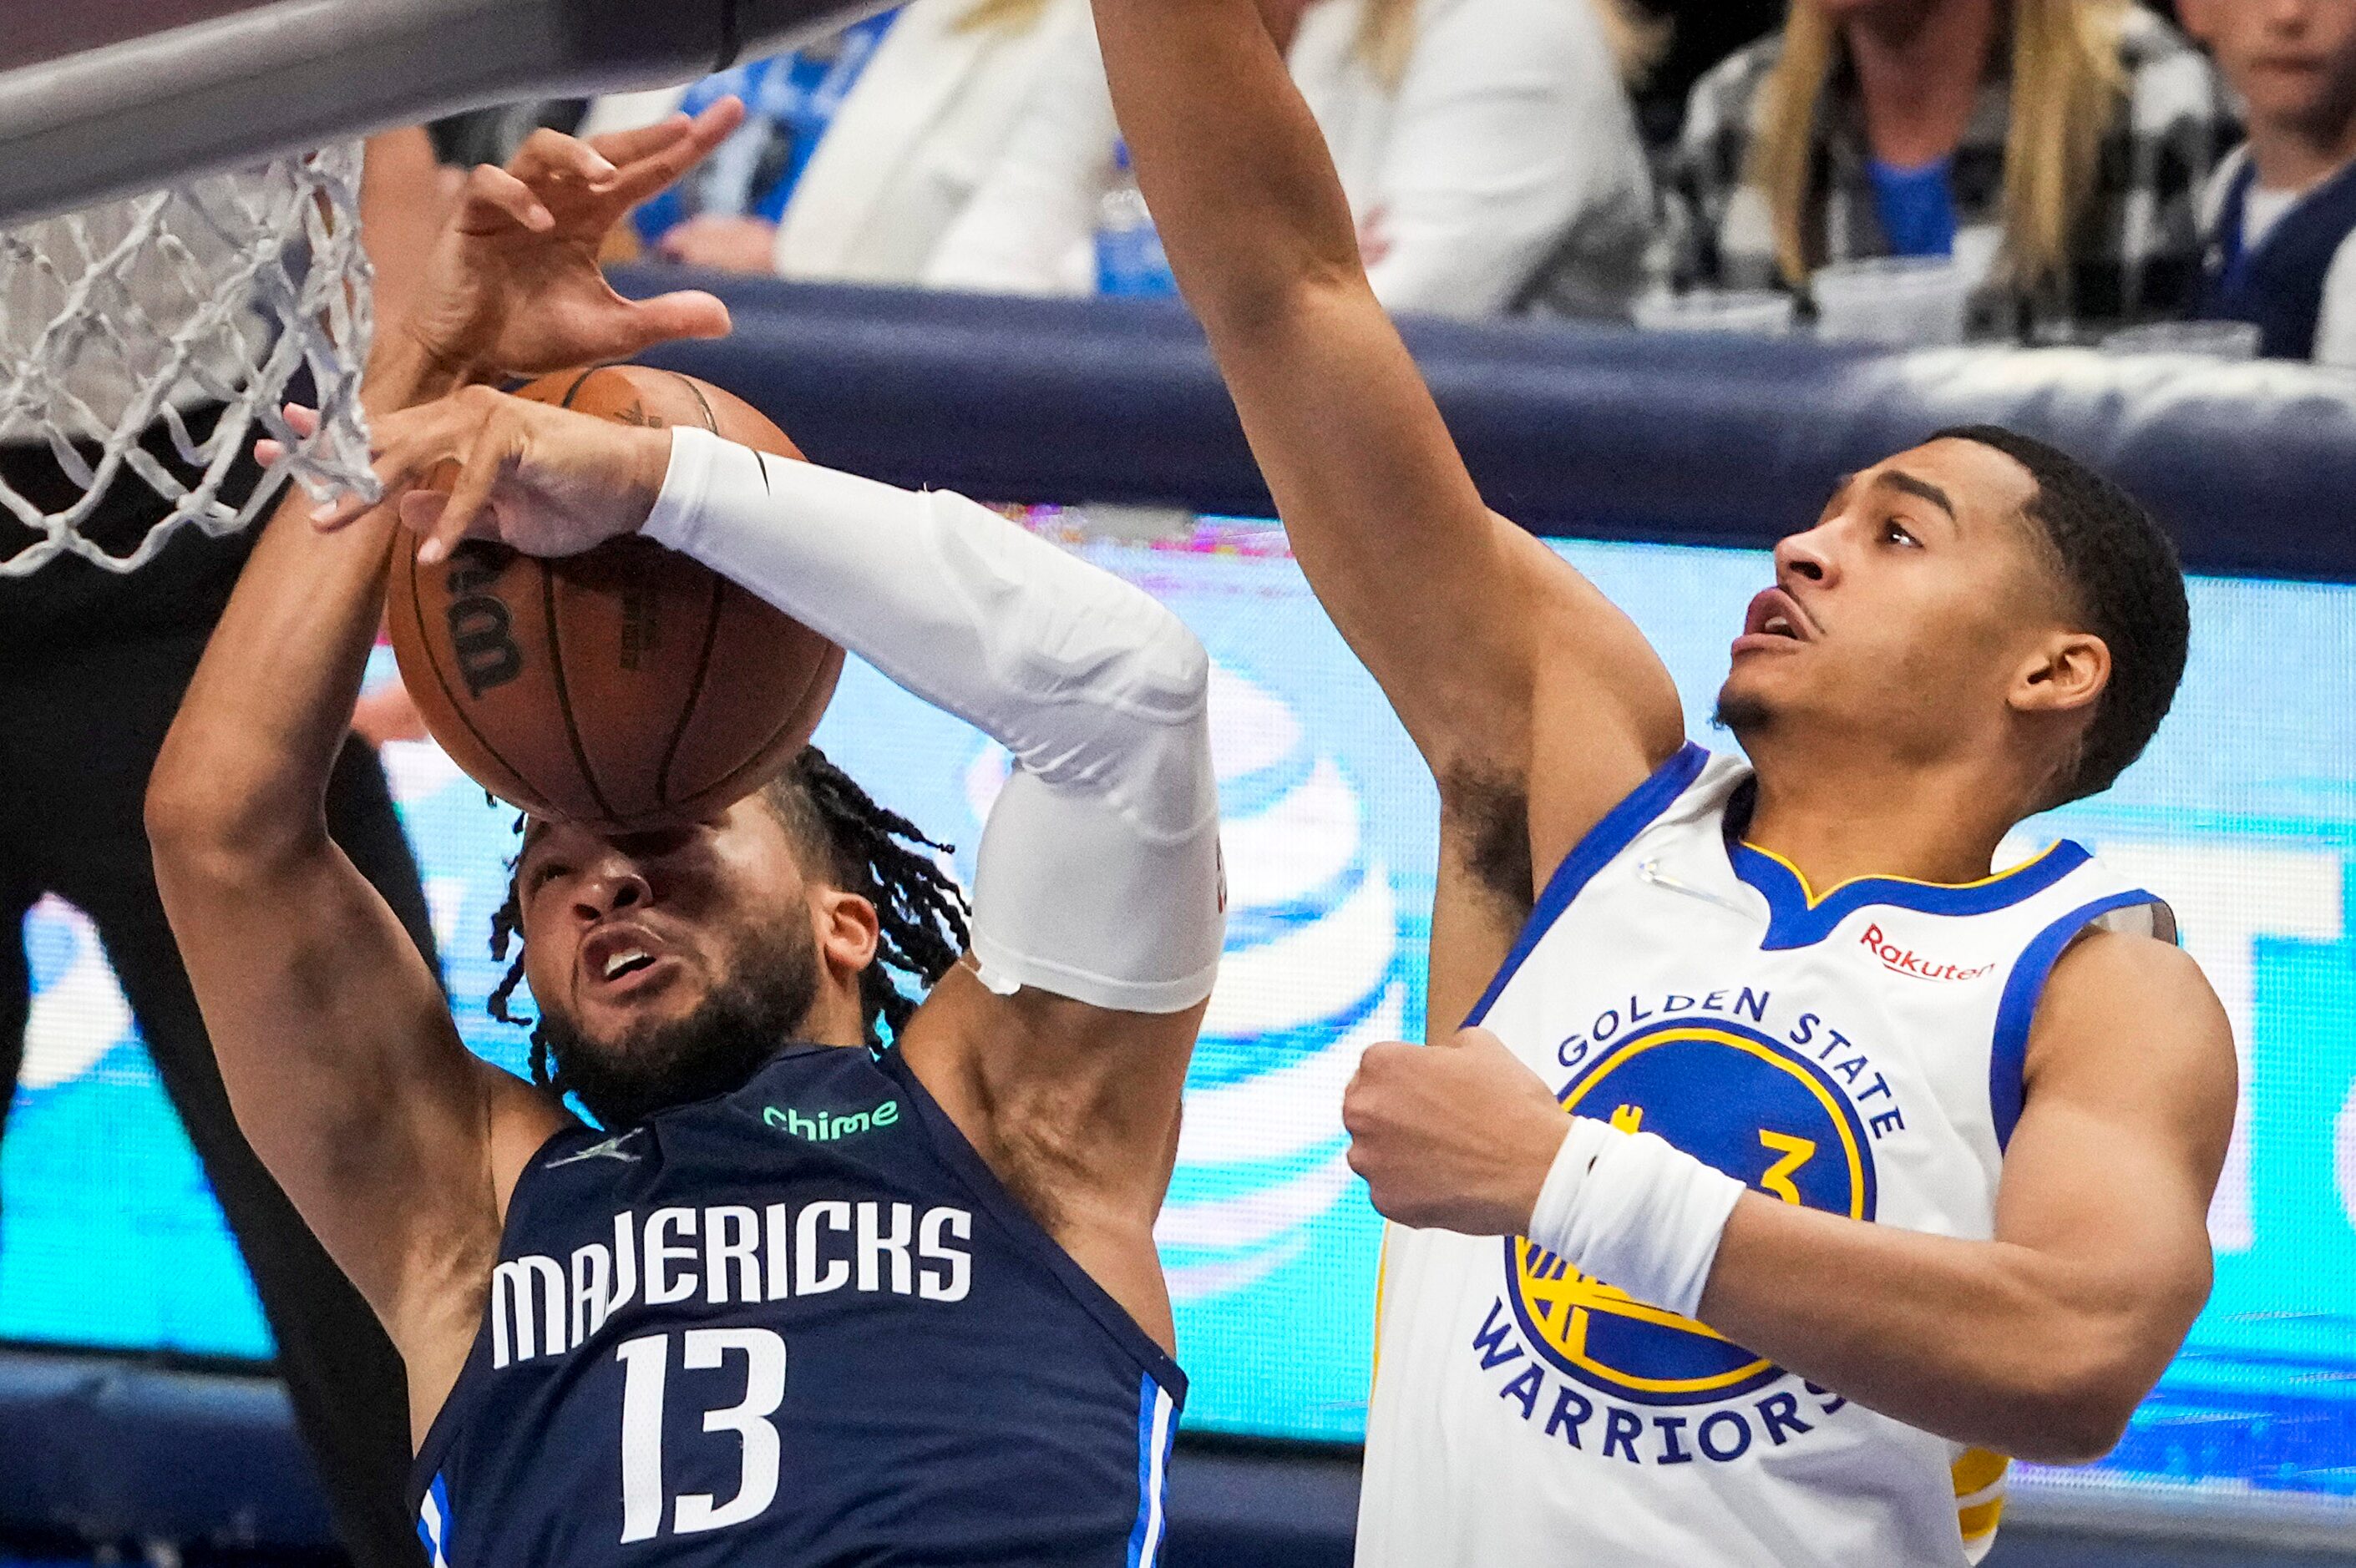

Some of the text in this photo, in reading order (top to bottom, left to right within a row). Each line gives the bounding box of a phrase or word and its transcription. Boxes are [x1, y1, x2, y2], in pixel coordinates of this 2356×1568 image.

[1860, 923, 1996, 982] Rakuten
[1557, 986, 1906, 1140] GOLDEN STATE
[492, 1200, 972, 1370] MAVERICKS
[616, 1327, 788, 1545] 13
